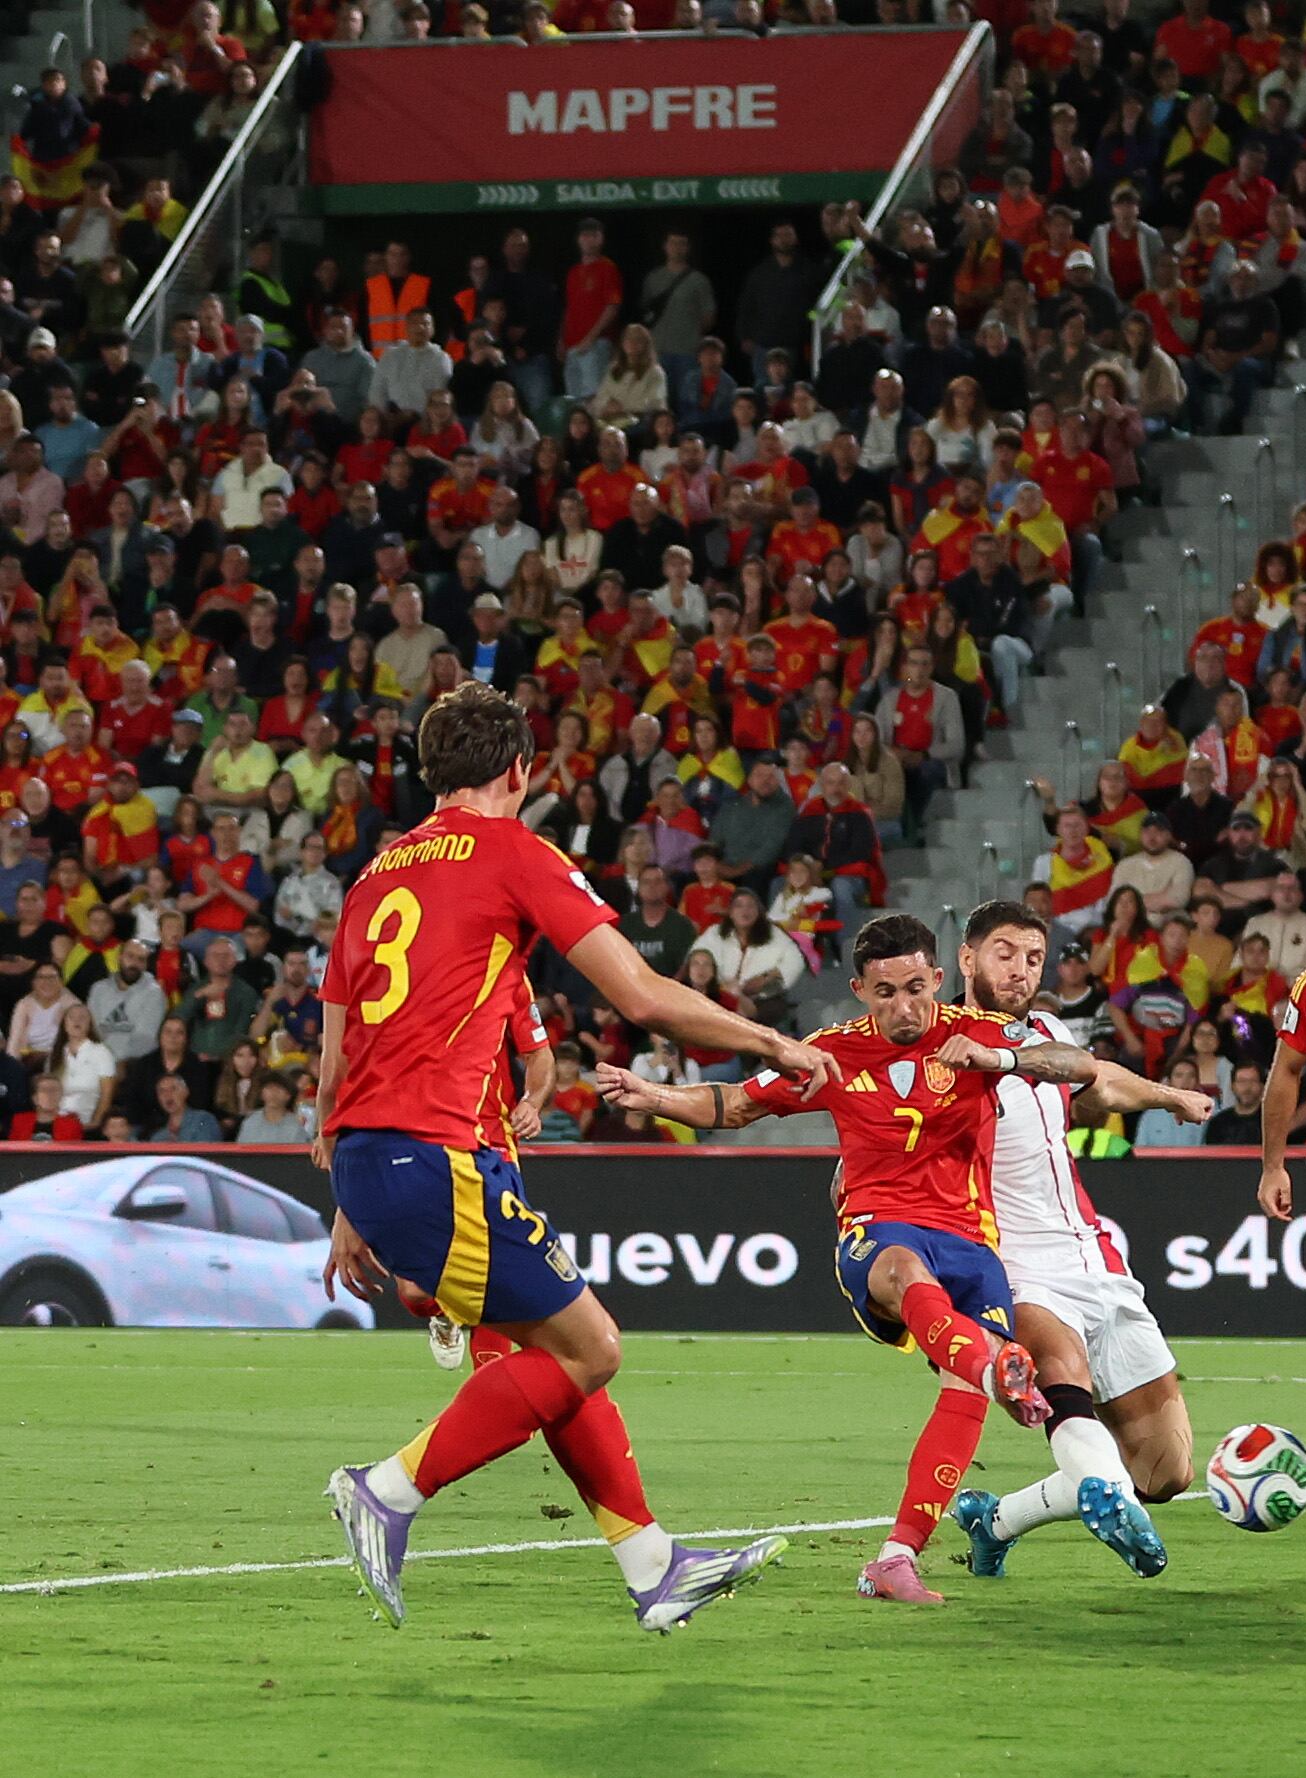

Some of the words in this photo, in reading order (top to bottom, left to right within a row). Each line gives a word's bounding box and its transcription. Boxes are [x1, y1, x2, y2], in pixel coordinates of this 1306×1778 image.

[507, 84, 777, 135] MAPFRE
[555, 182, 636, 203] SALIDA
[653, 179, 700, 200] EXIT
[360, 886, 423, 1025] 3
[893, 1107, 924, 1153] 7
[501, 1189, 546, 1246] 3
[541, 1211, 800, 1287] uevo
